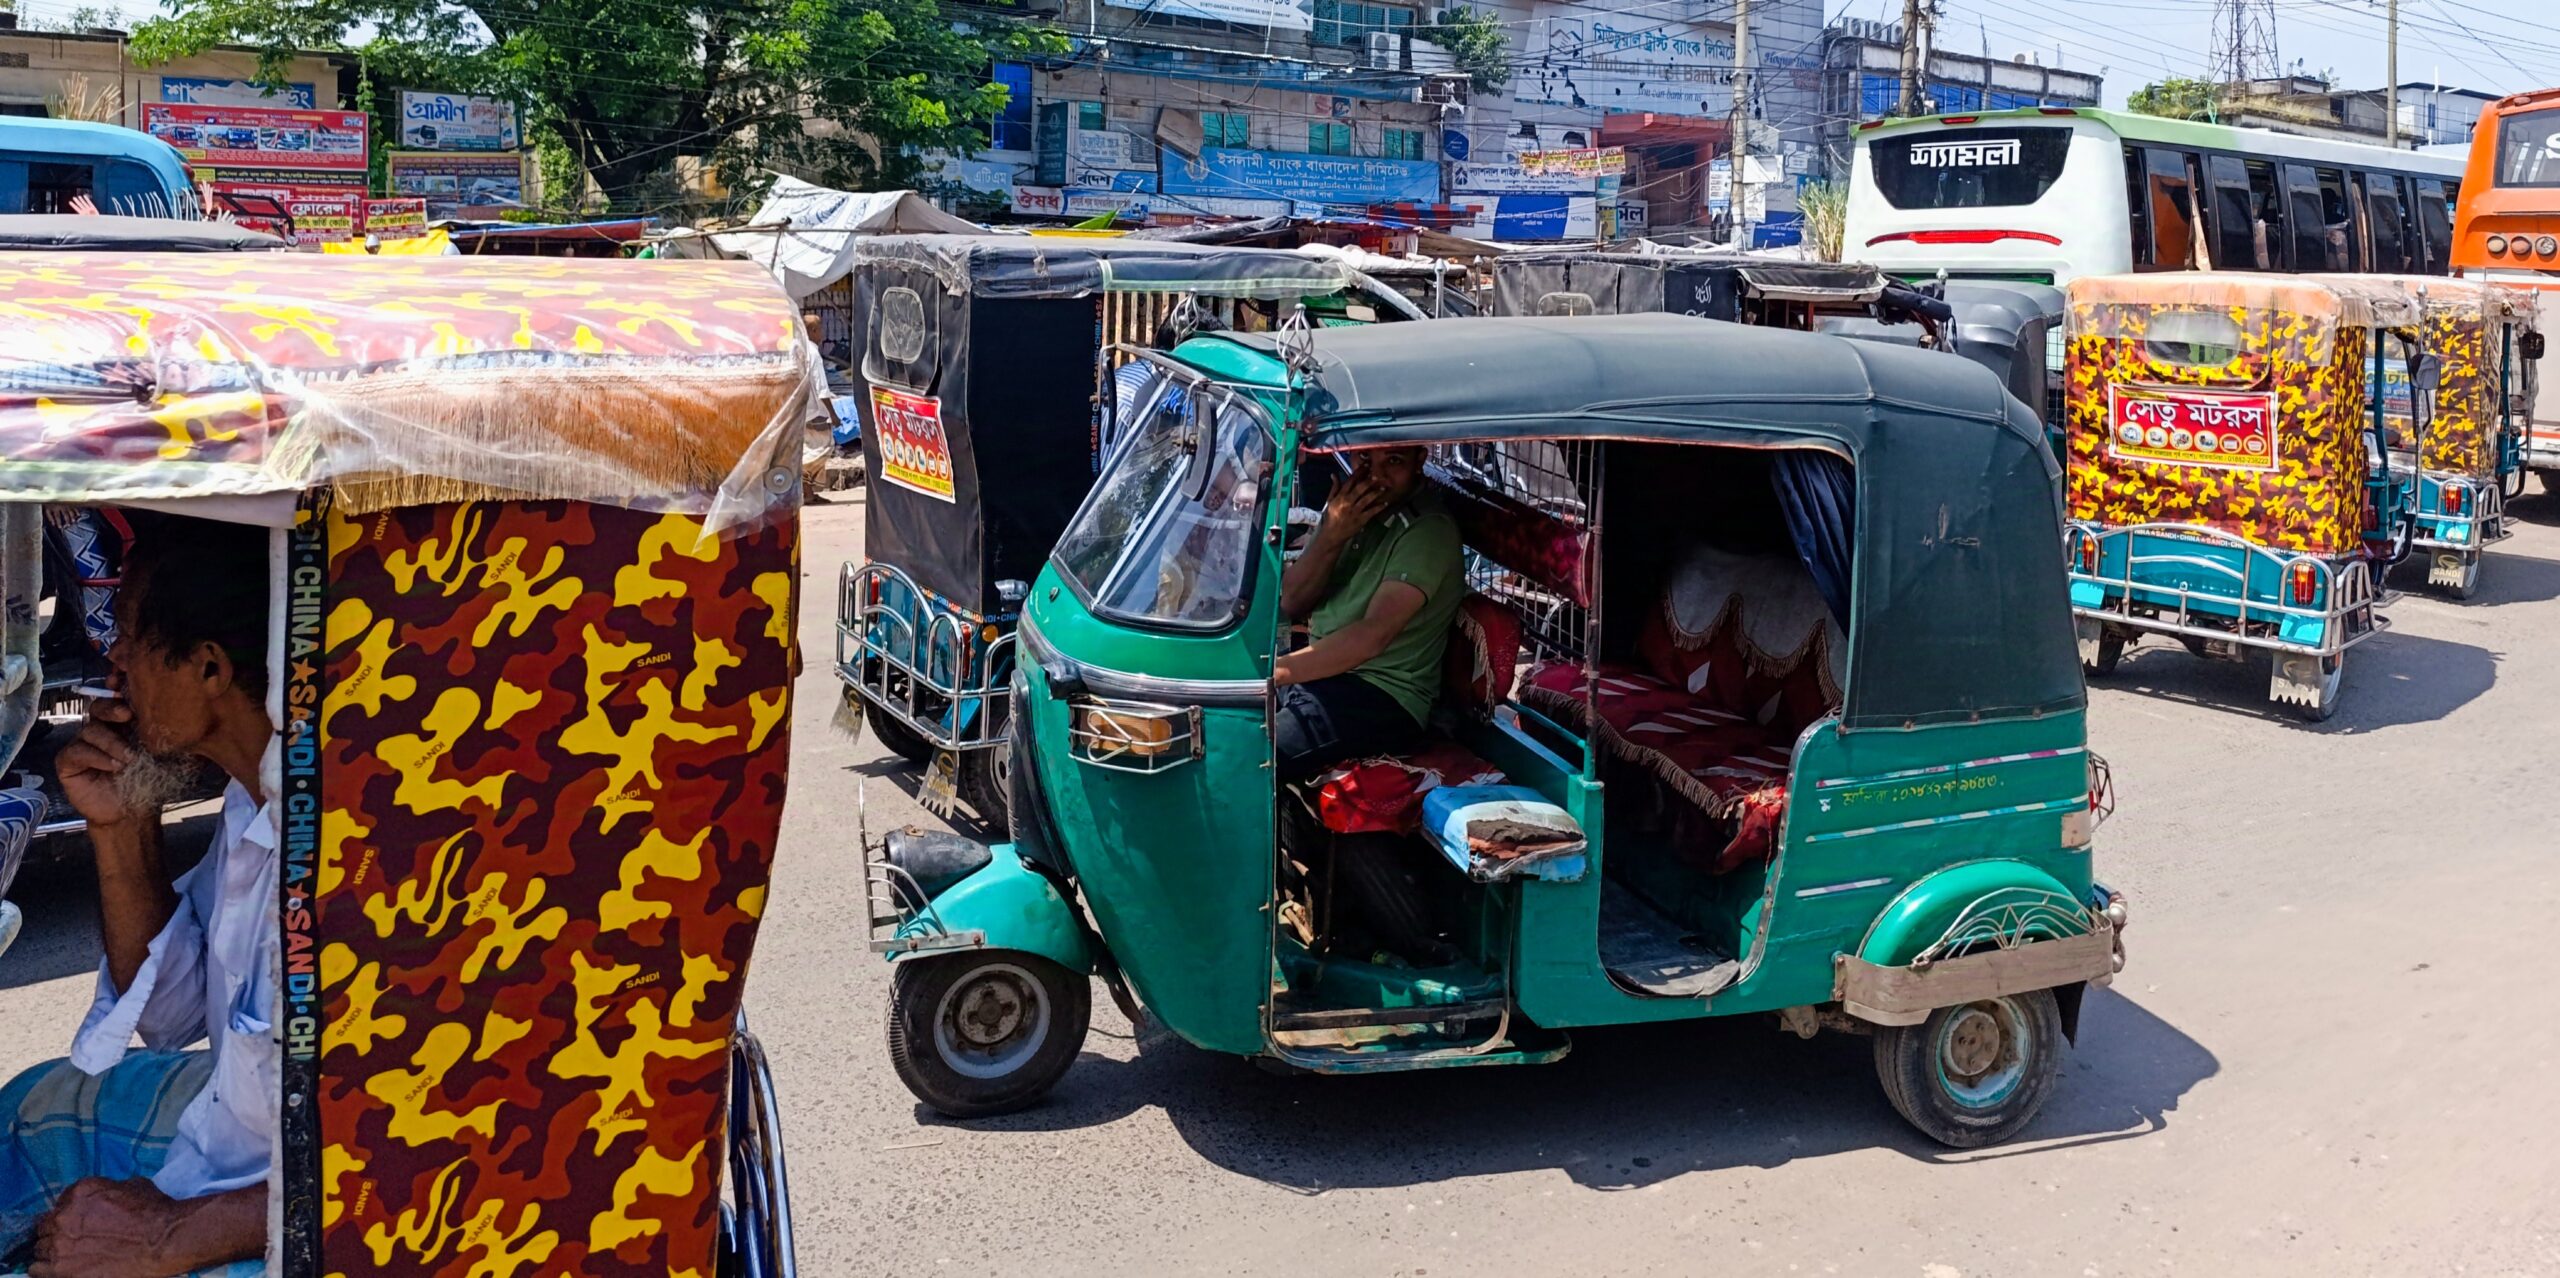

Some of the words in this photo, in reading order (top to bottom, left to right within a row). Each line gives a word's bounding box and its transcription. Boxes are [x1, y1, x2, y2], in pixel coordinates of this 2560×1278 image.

[1672, 36, 1700, 56] ব্যাংক
[1703, 34, 1736, 60] লিমিটে
[407, 96, 467, 122] গ্রামীণ
[1216, 152, 1263, 169] ইসলামী
[1268, 158, 1302, 172] ব্যাংক
[1306, 159, 1359, 176] বাংলাদেশ
[1363, 161, 1409, 178] লিমিটেড
[1909, 138, 2021, 169] শ্যামলী
[1016, 188, 1060, 210] ঔষধ
[1245, 176, 1273, 186] Islami
[1275, 177, 1300, 187] Bank
[1302, 179, 1351, 191] Bangladesh
[1353, 182, 1386, 192] Limited
[2126, 399, 2179, 430] সেতু
[2185, 399, 2264, 435] মটরস্
[489, 551, 517, 582] SANDI
[2434, 568, 2461, 579] SANDI
[290, 566, 322, 660] CHINA
[636, 651, 672, 668] SANDI
[344, 664, 374, 698] SANDI
[287, 685, 318, 777] SANDI
[413, 740, 446, 769] SANDI
[606, 787, 641, 805] SANDI
[282, 794, 316, 885] CHINA
[353, 848, 376, 885] SANDI
[472, 886, 499, 918] SANDI
[285, 908, 317, 1004] SANDI
[626, 971, 661, 989] SANDI
[336, 1006, 364, 1038] SANDI
[404, 1074, 435, 1103] SANDI
[600, 1107, 634, 1127] SANDI
[352, 1180, 373, 1216] SANDI
[466, 1213, 494, 1245] SANDI
